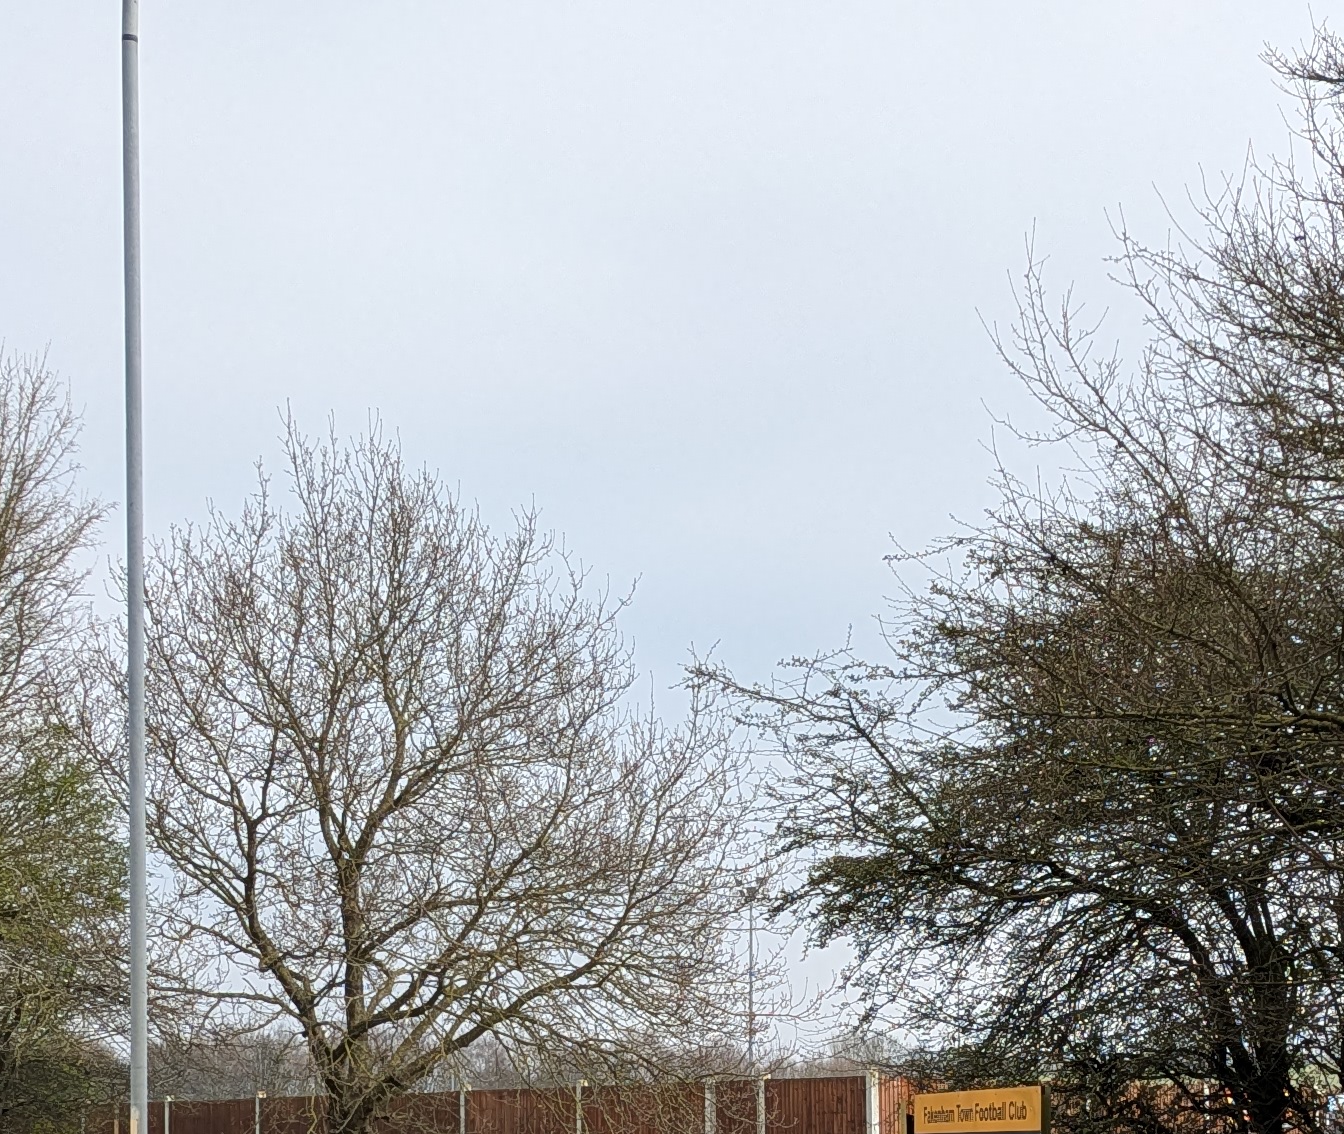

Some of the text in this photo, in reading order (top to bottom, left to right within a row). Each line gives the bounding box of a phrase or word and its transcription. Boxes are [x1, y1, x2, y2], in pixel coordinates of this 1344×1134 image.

[923, 1100, 1027, 1124] Fakenham Town Football Club
